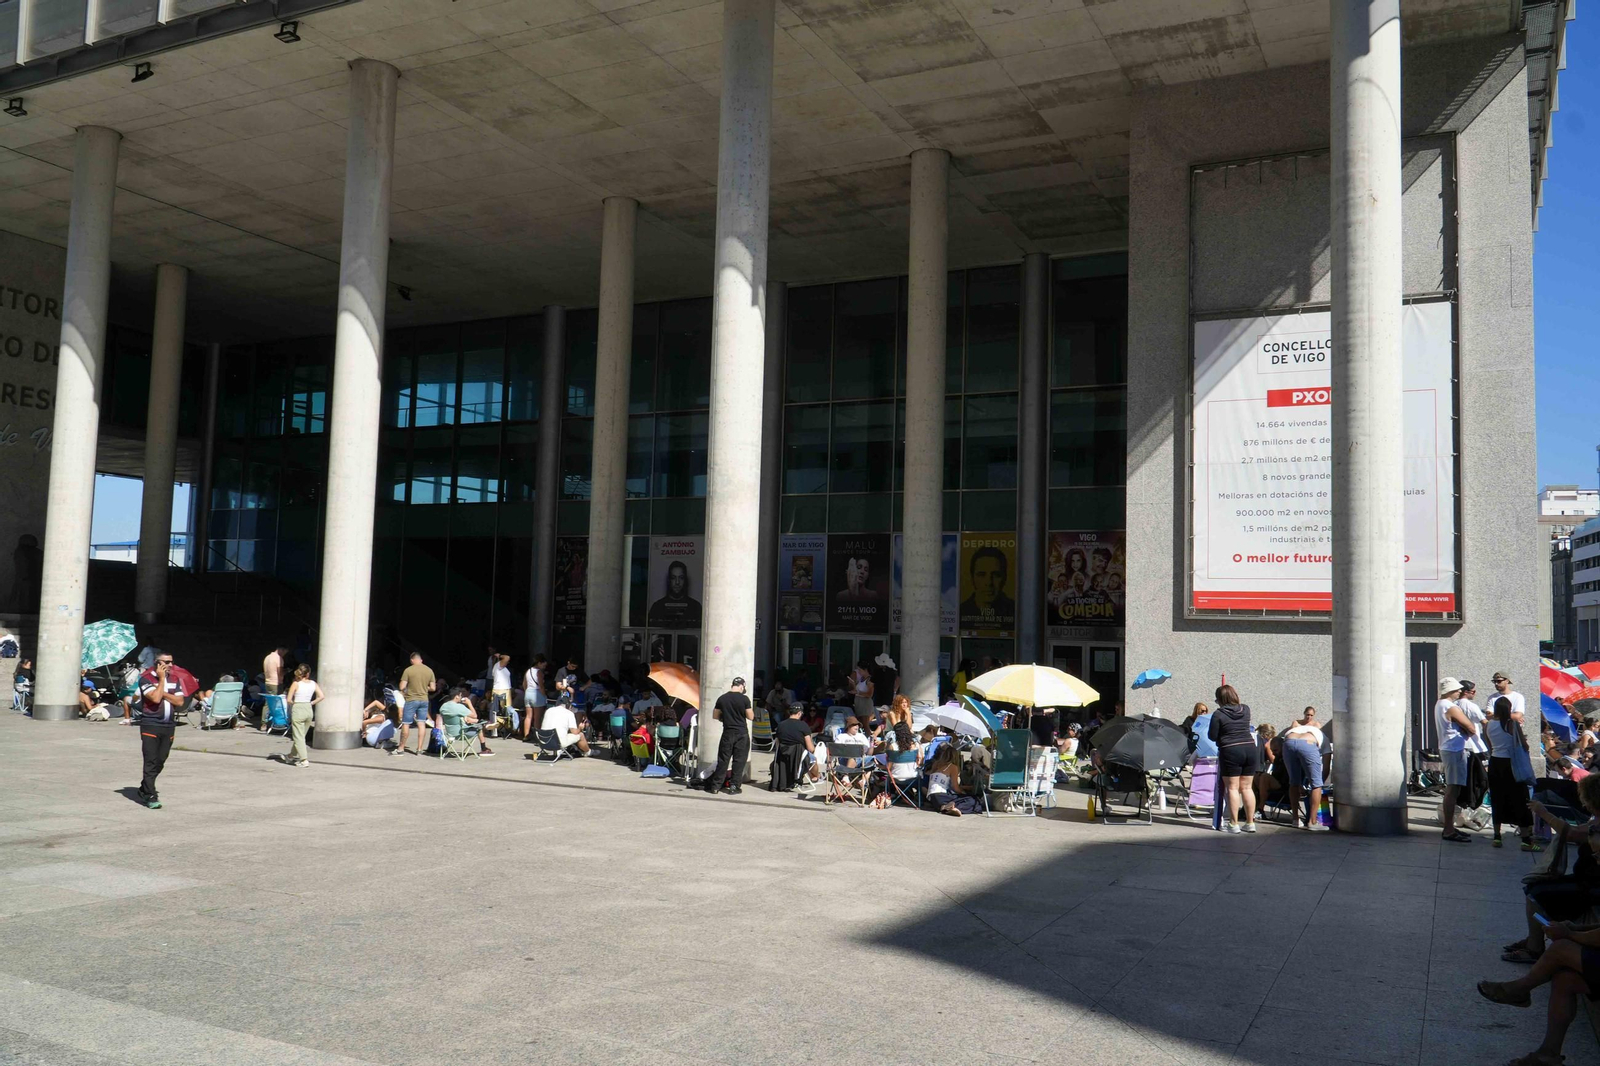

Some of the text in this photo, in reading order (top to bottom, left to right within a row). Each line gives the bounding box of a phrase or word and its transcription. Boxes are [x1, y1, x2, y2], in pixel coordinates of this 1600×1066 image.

[0, 333, 23, 358] O
[1263, 339, 1331, 353] CONCELLO
[1272, 352, 1325, 364] DE VIGO
[2, 383, 55, 411] RES
[1292, 390, 1331, 404] PXO
[1256, 420, 1327, 429] 14.664 vivendas
[1262, 438, 1293, 446] millóns
[1296, 437, 1307, 445] de
[1319, 436, 1331, 444] de
[1241, 457, 1254, 465] 2,7
[1290, 455, 1302, 463] de
[1236, 509, 1275, 517] 900.000
[1243, 525, 1254, 533] 1,5
[1079, 533, 1097, 541] VIGO
[962, 539, 1015, 548] DEPEDRO
[1232, 553, 1242, 563] O
[1247, 553, 1289, 563] mellor
[859, 606, 877, 614] VIGO
[980, 607, 995, 616] VIGO
[1058, 602, 1115, 620] COMEDIA
